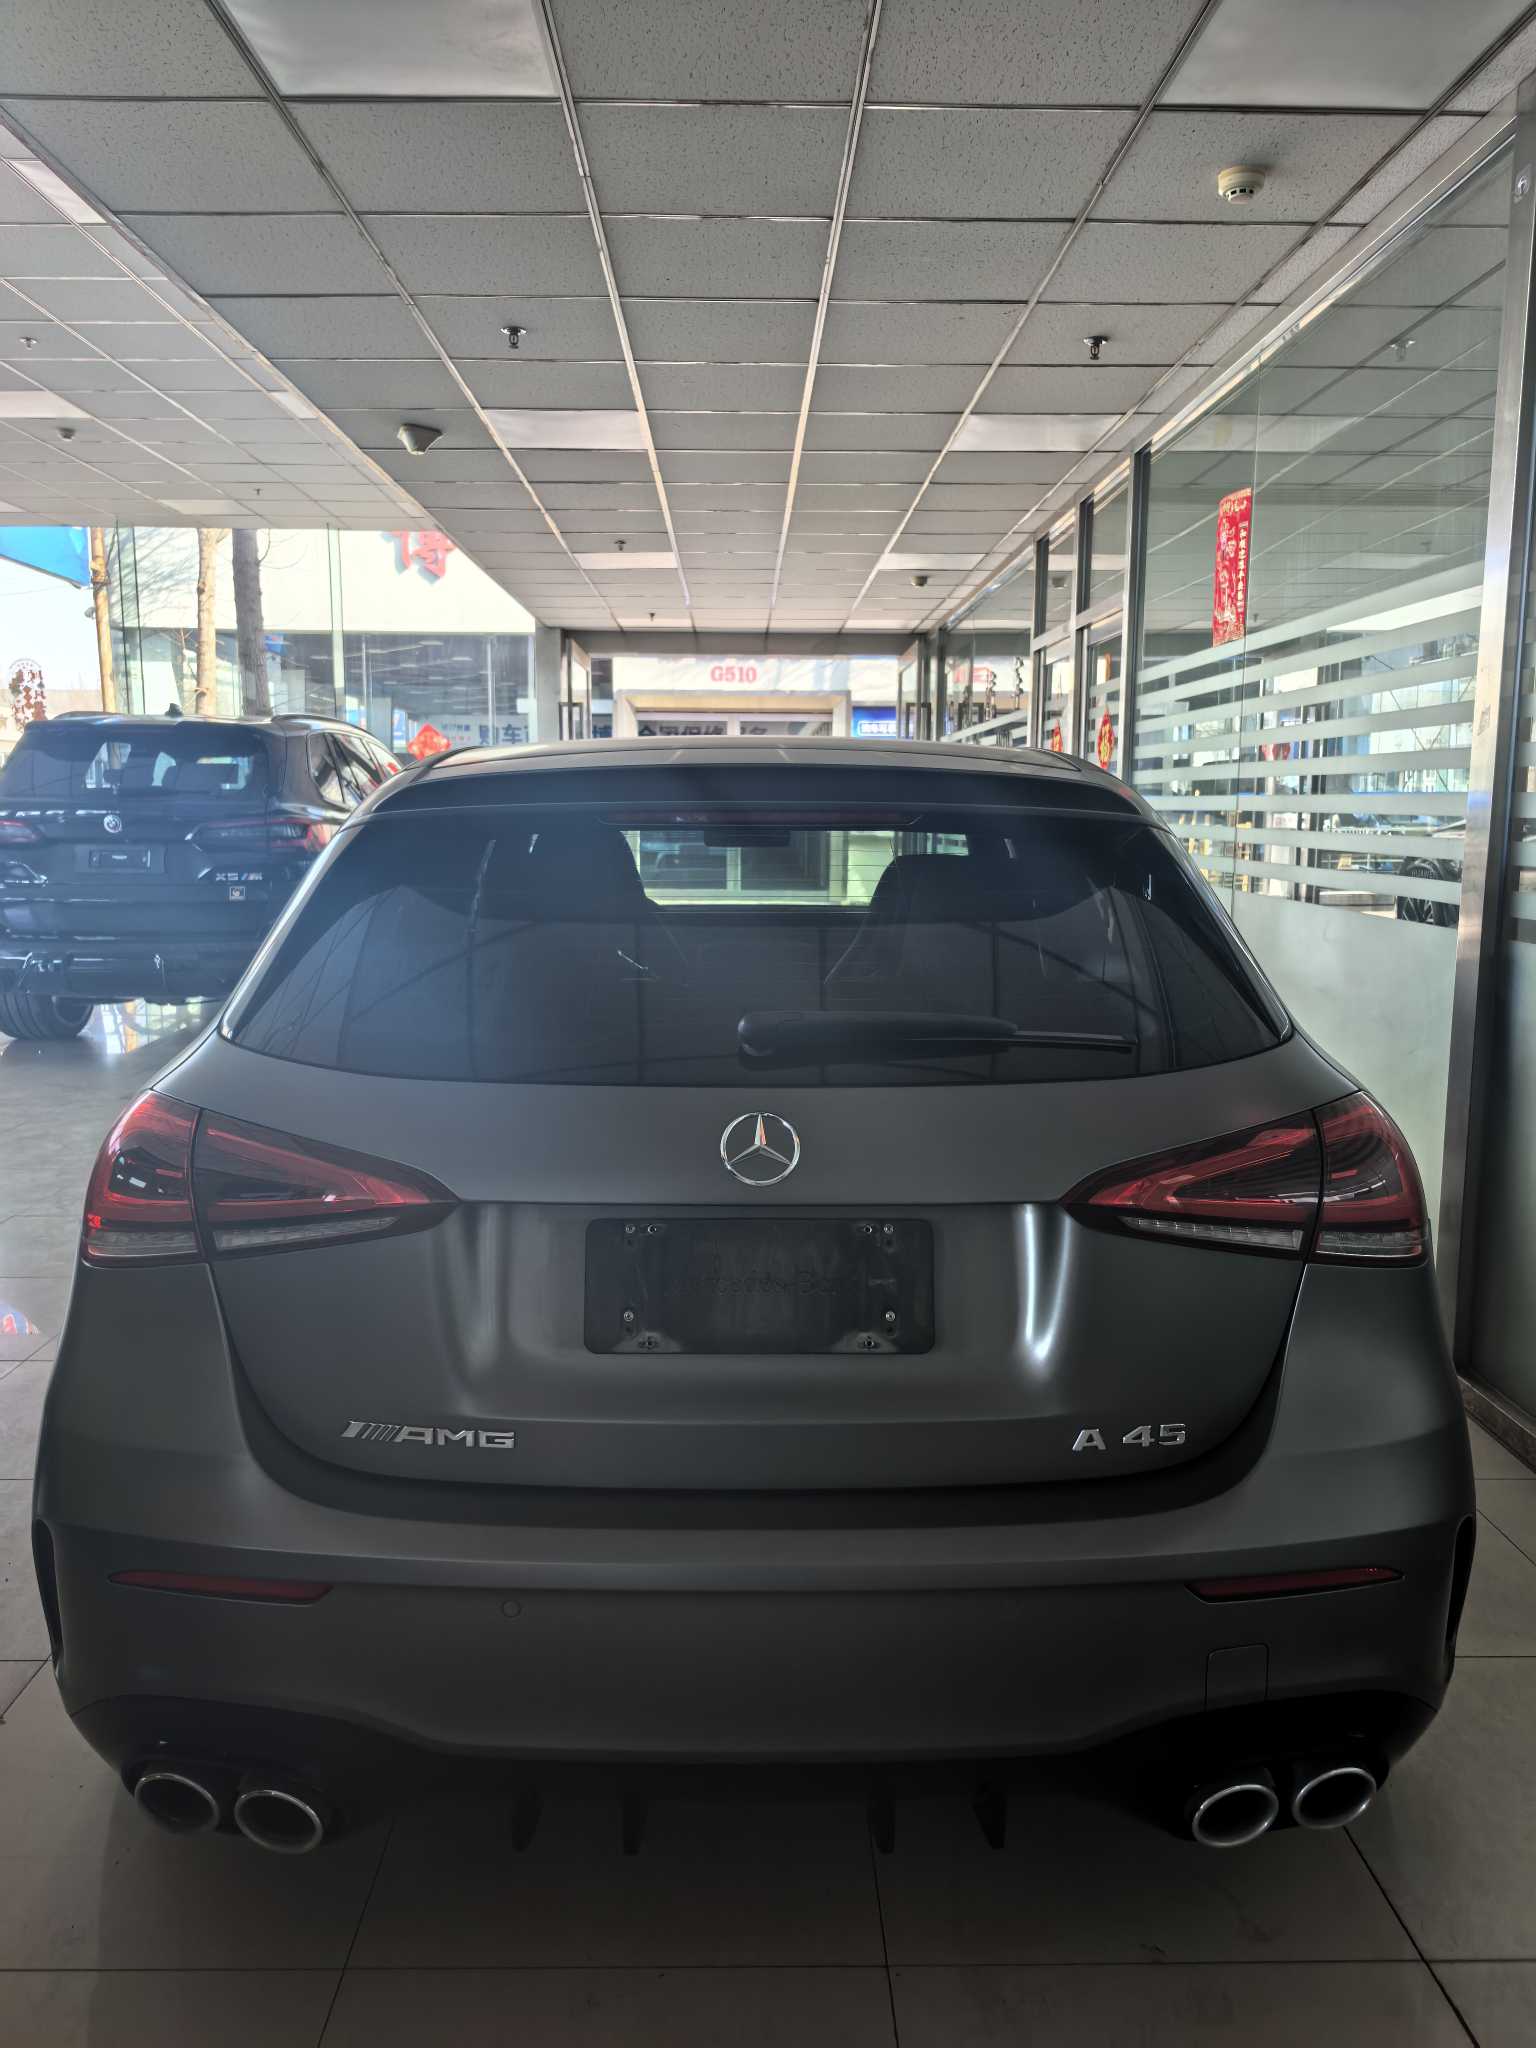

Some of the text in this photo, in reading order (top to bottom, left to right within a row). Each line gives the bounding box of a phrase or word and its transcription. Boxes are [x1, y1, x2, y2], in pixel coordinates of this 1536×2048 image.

[710, 666, 757, 684] G510
[394, 1425, 515, 1448] AMG
[1072, 1424, 1185, 1451] A 45
